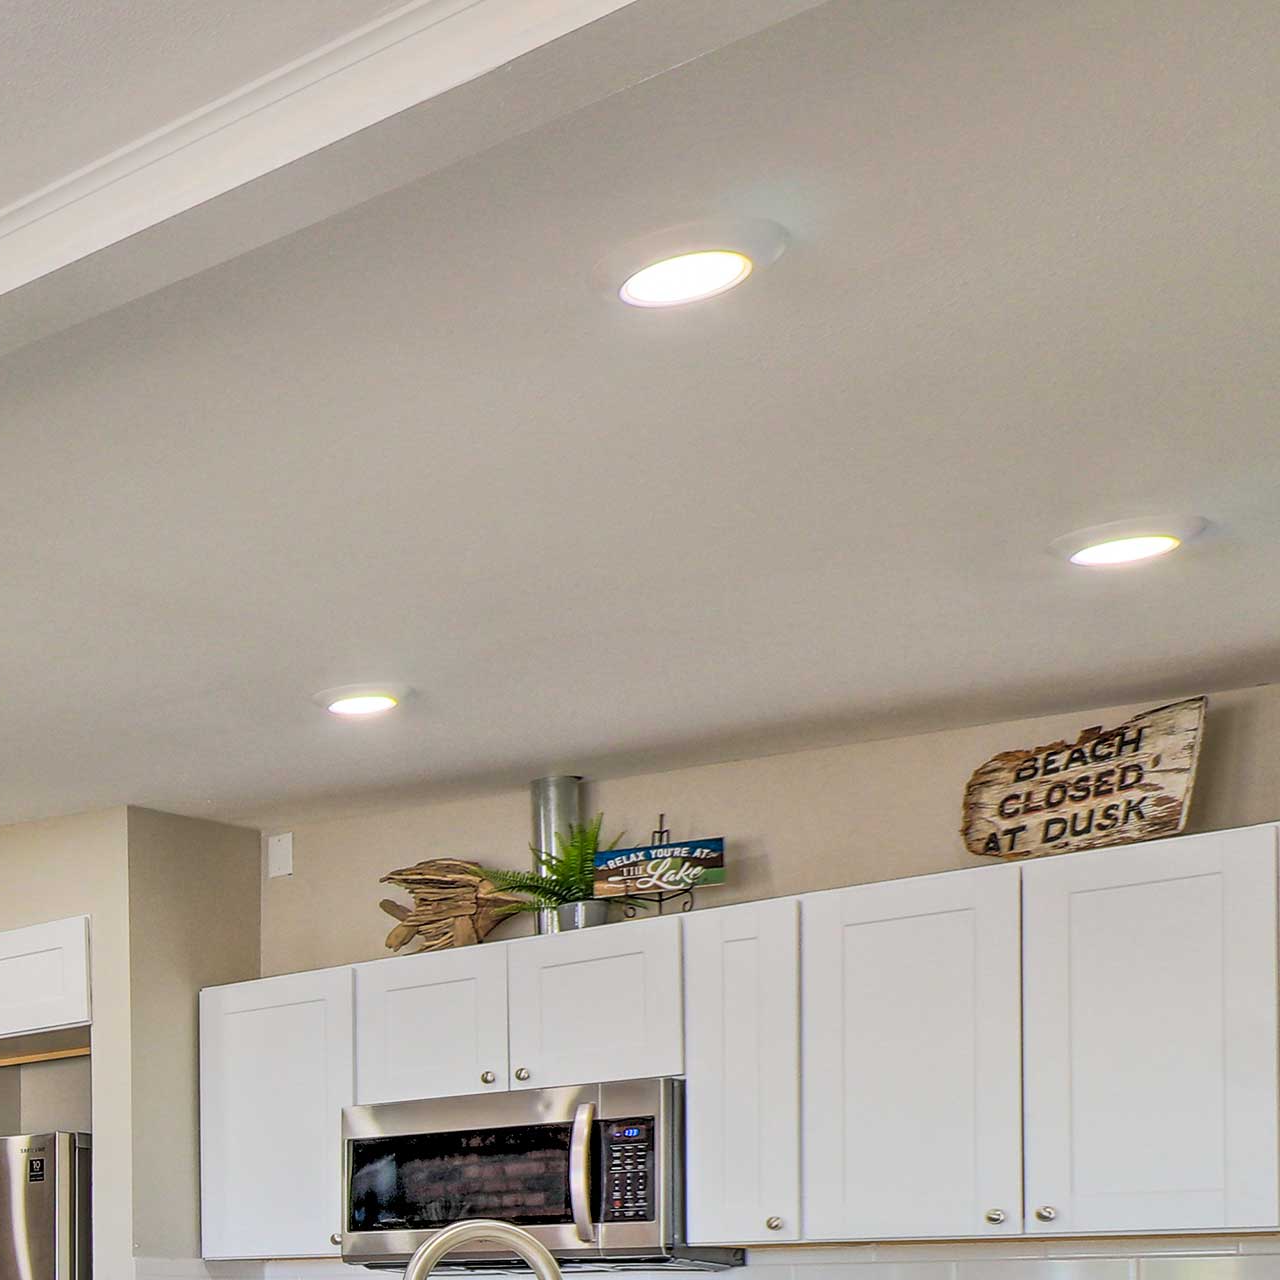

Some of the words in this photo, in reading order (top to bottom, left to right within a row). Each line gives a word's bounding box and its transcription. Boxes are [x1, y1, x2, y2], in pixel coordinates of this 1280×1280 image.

[1014, 727, 1146, 783] BEACH
[998, 764, 1144, 818] CLOSED
[983, 824, 1027, 853] AT
[1042, 796, 1148, 844] DUSK
[607, 850, 646, 870] RELAX
[649, 847, 691, 859] YOU'RE
[692, 847, 711, 859] AT
[635, 857, 705, 889] Lake
